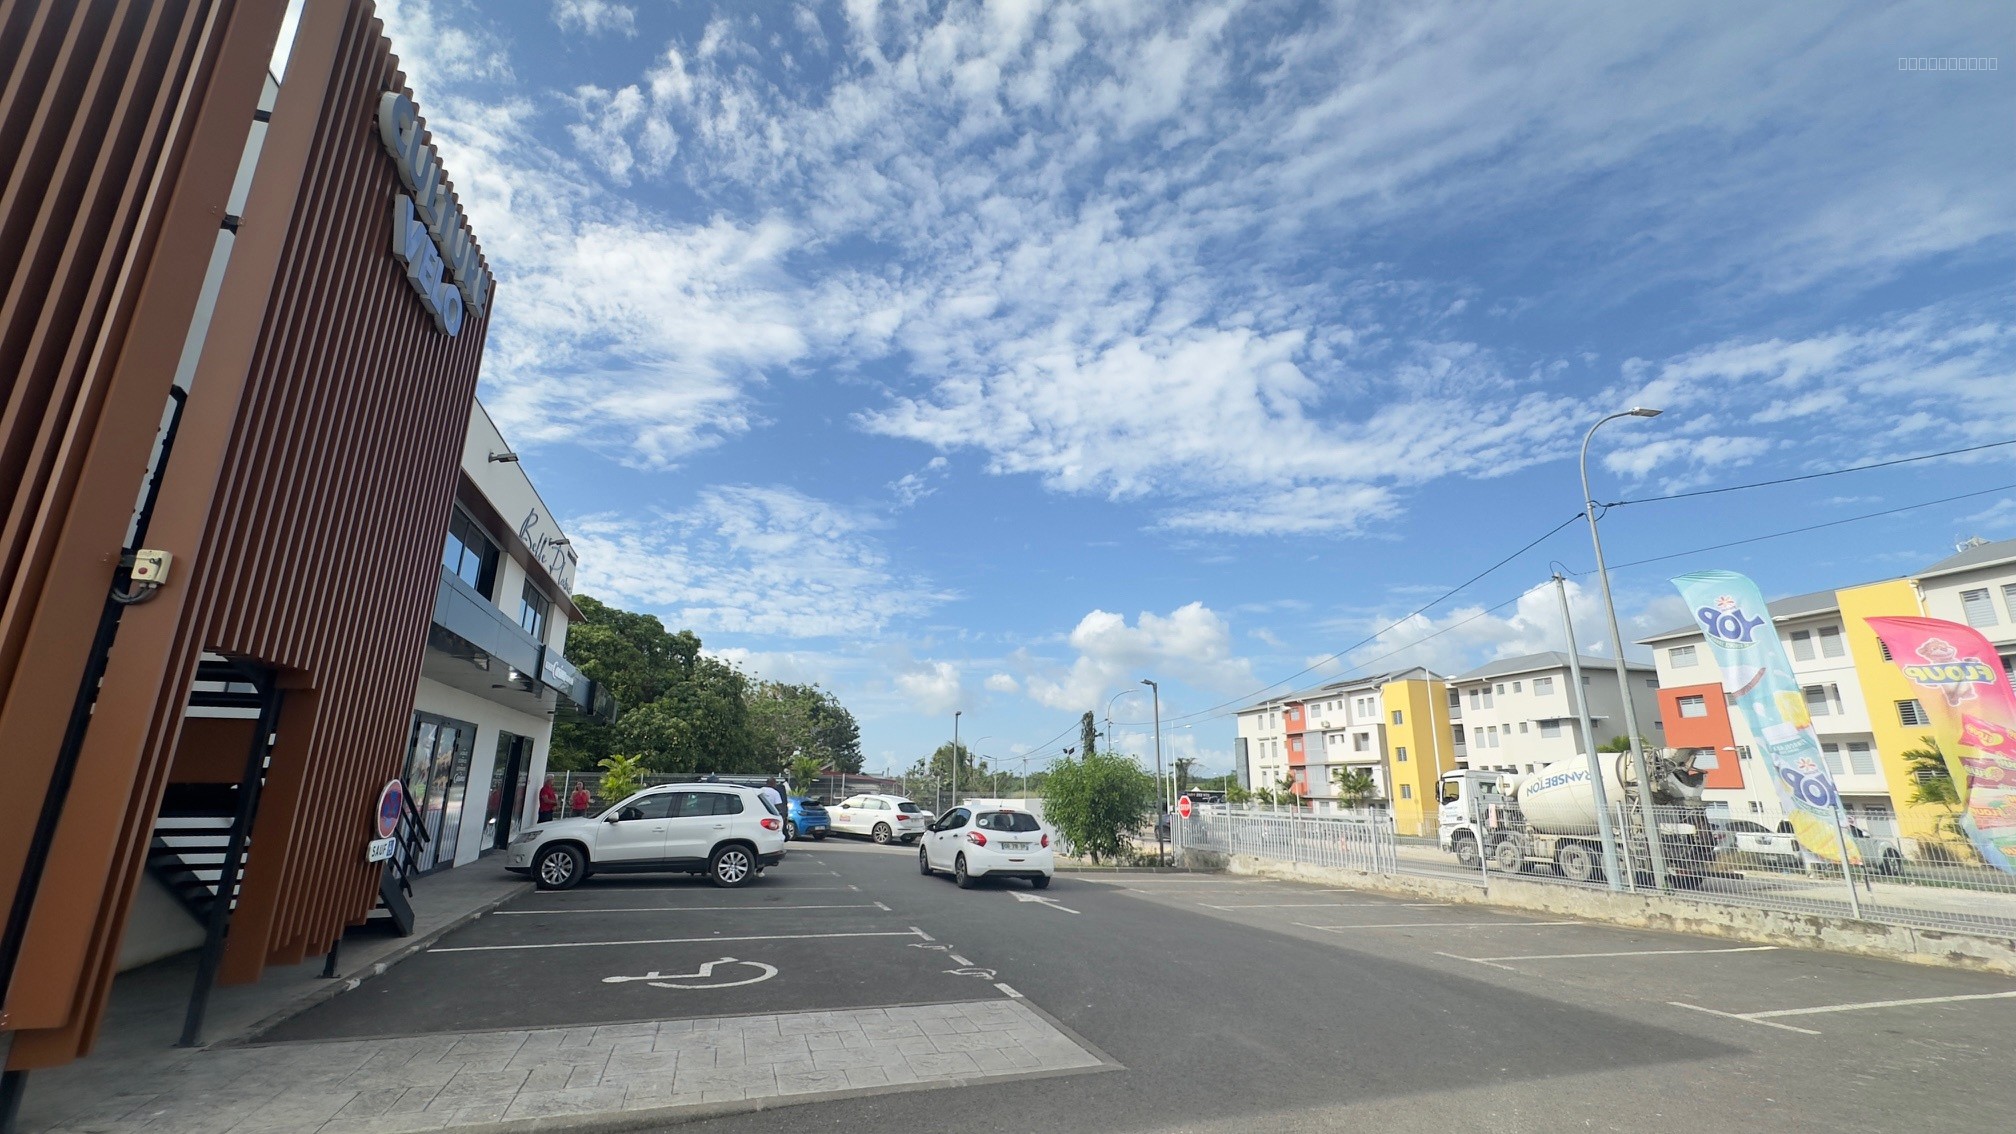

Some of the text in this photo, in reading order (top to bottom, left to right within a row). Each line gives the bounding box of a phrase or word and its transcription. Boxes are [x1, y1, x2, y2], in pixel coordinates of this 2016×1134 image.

[379, 91, 489, 318] CULTURE
[393, 194, 463, 336] VELO
[519, 508, 547, 563] Belle
[1526, 768, 1604, 797] RANSBETON
[371, 843, 387, 857] SAUF
